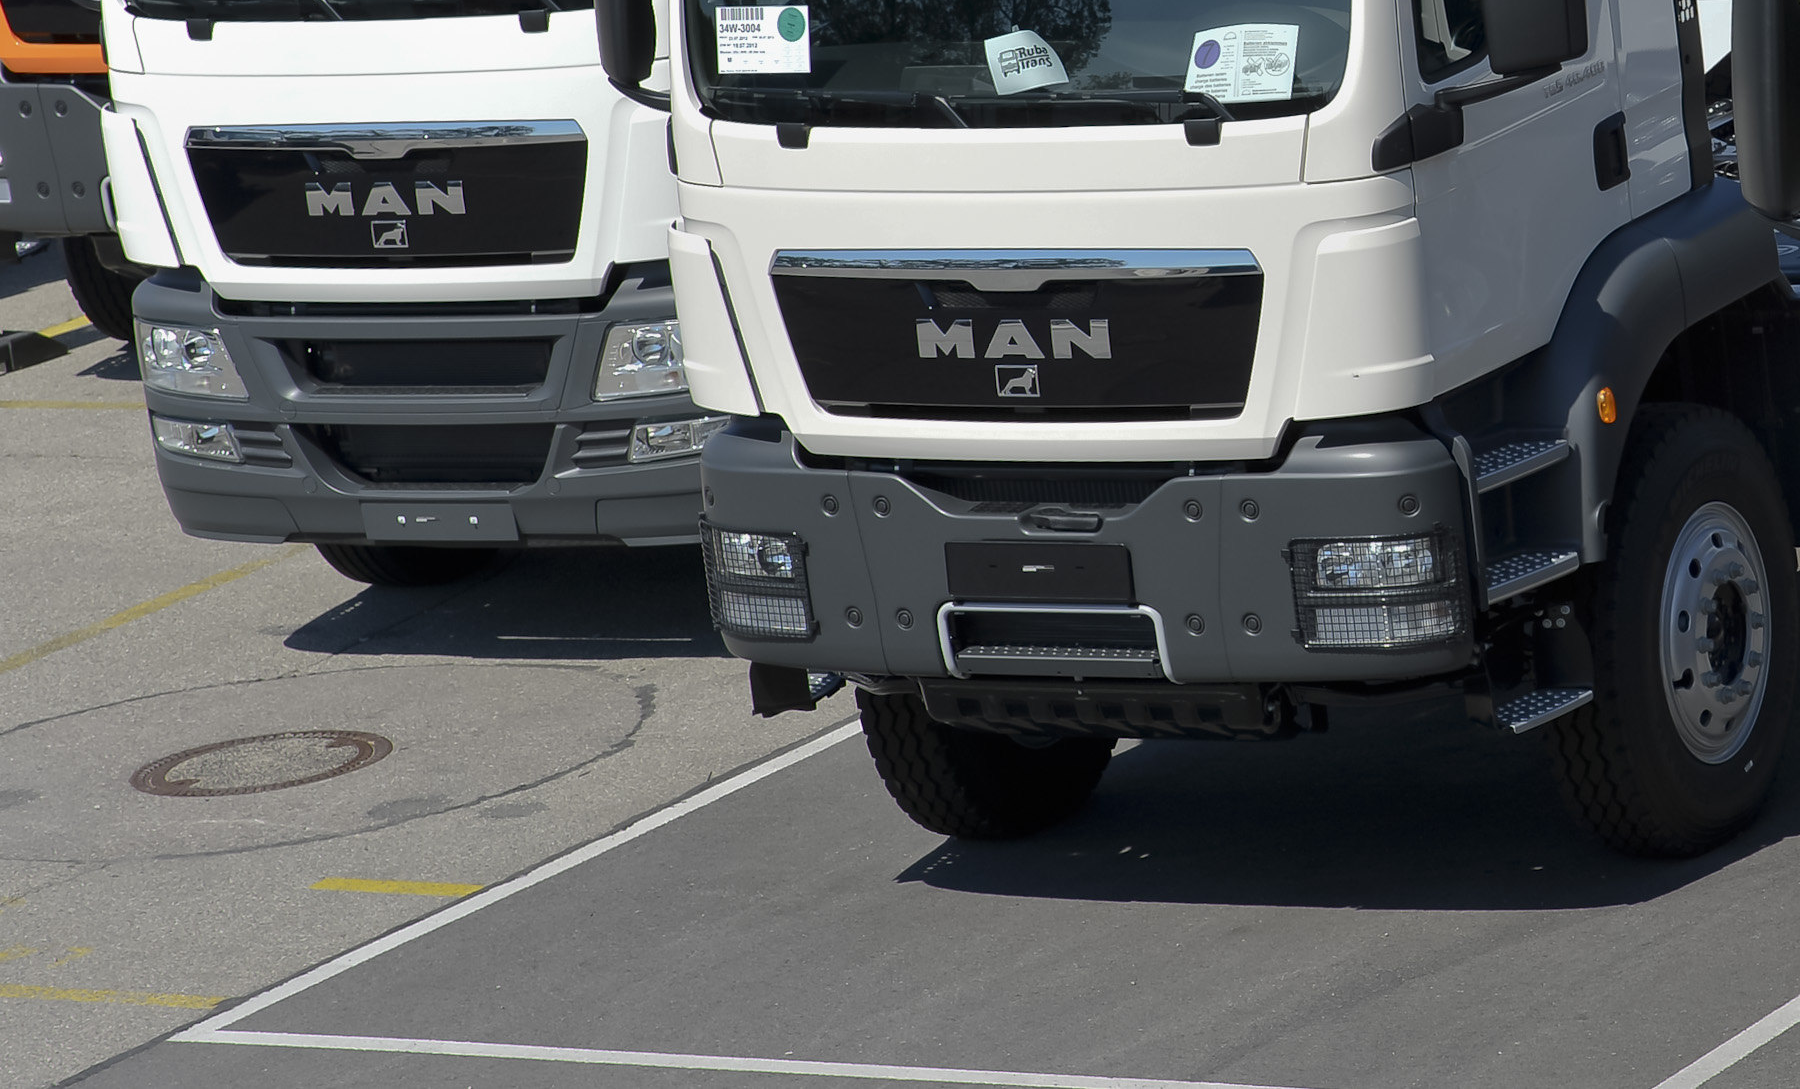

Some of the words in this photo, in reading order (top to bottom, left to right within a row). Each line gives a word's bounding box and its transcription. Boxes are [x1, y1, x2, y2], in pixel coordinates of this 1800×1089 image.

[719, 23, 761, 33] 34W-3004
[1018, 45, 1048, 58] Ruba
[1019, 57, 1052, 70] Trans
[305, 181, 467, 216] MAN
[915, 318, 1112, 360] MAN
